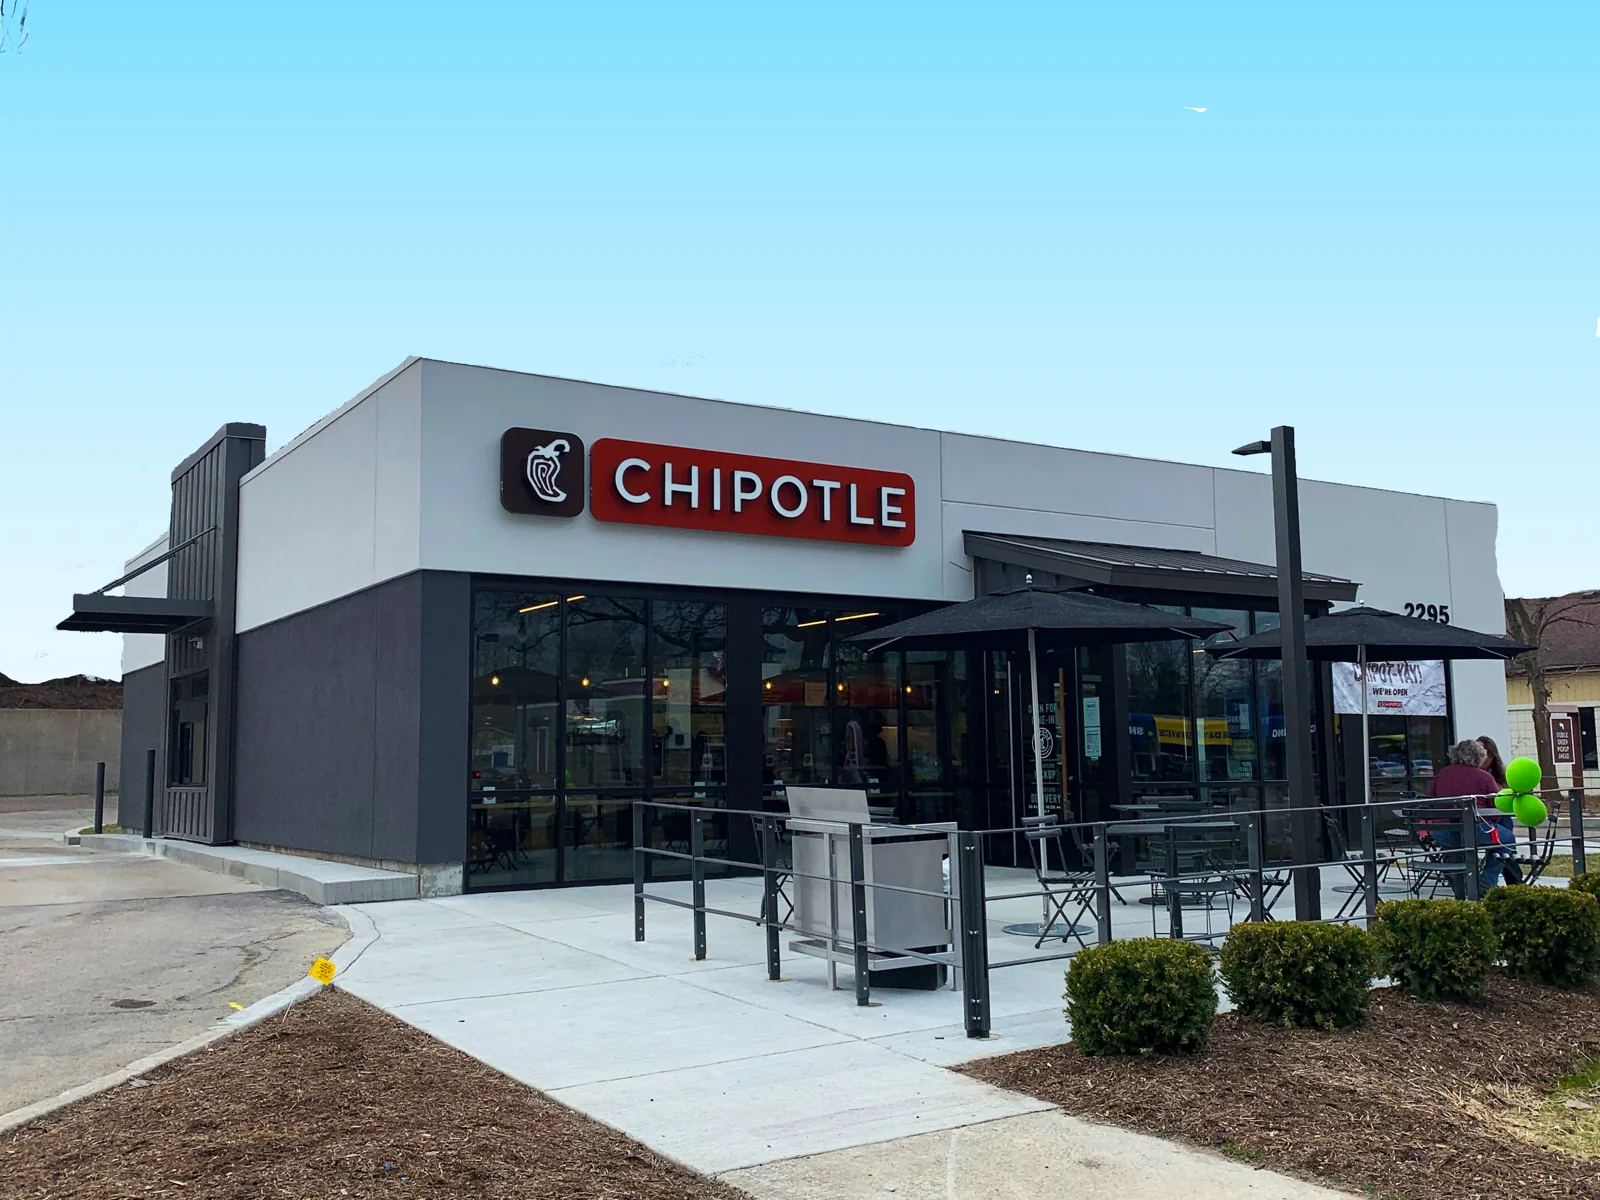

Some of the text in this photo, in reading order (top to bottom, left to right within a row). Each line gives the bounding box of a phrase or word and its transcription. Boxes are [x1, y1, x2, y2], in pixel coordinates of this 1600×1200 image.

[615, 458, 906, 528] CHIPOTLE
[1404, 602, 1450, 625] 2295
[1372, 687, 1408, 696] WE'RE OPEN
[1028, 703, 1057, 714] ON FOR
